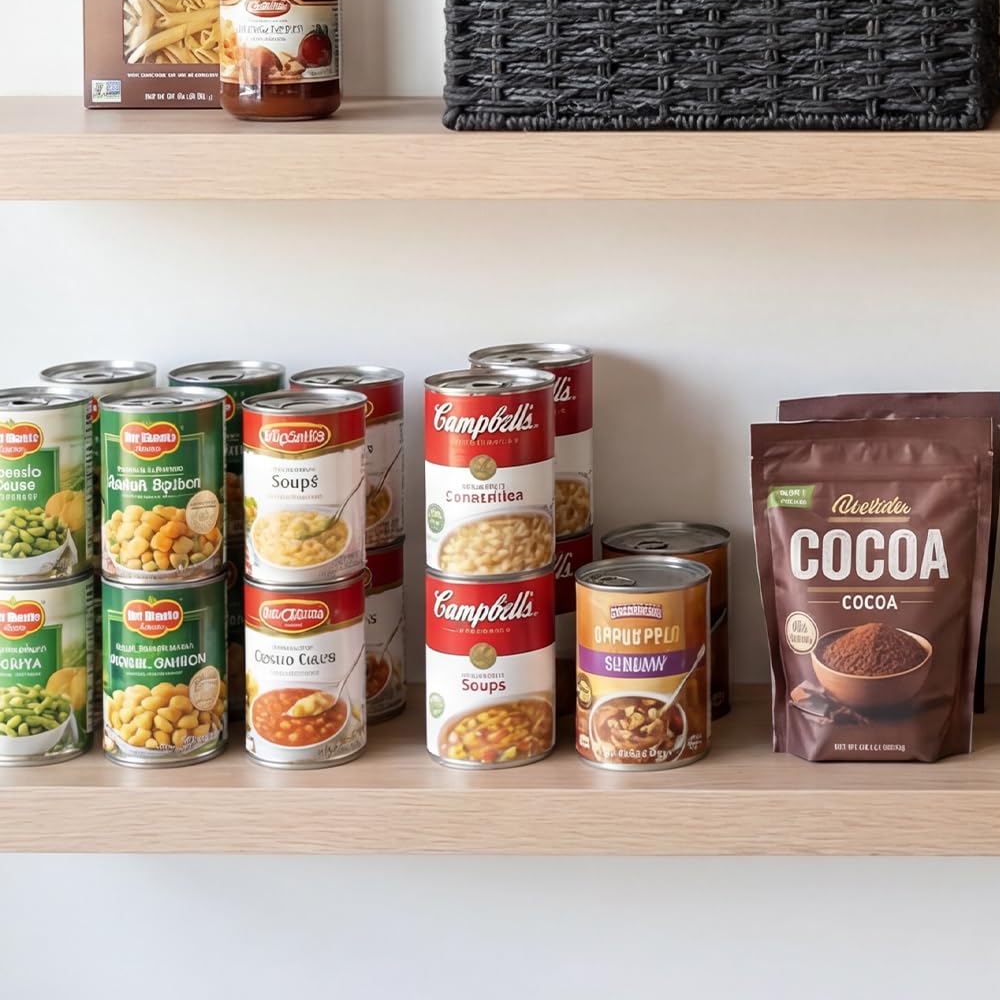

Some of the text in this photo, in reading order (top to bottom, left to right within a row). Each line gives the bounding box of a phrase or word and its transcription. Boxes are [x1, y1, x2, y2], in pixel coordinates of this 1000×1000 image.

[433, 403, 534, 441] Campbell's
[272, 475, 318, 492] Soups
[790, 529, 949, 581] COCOA
[434, 590, 534, 629] Campbell's
[842, 595, 898, 610] COCOA
[462, 678, 506, 694] Soups
